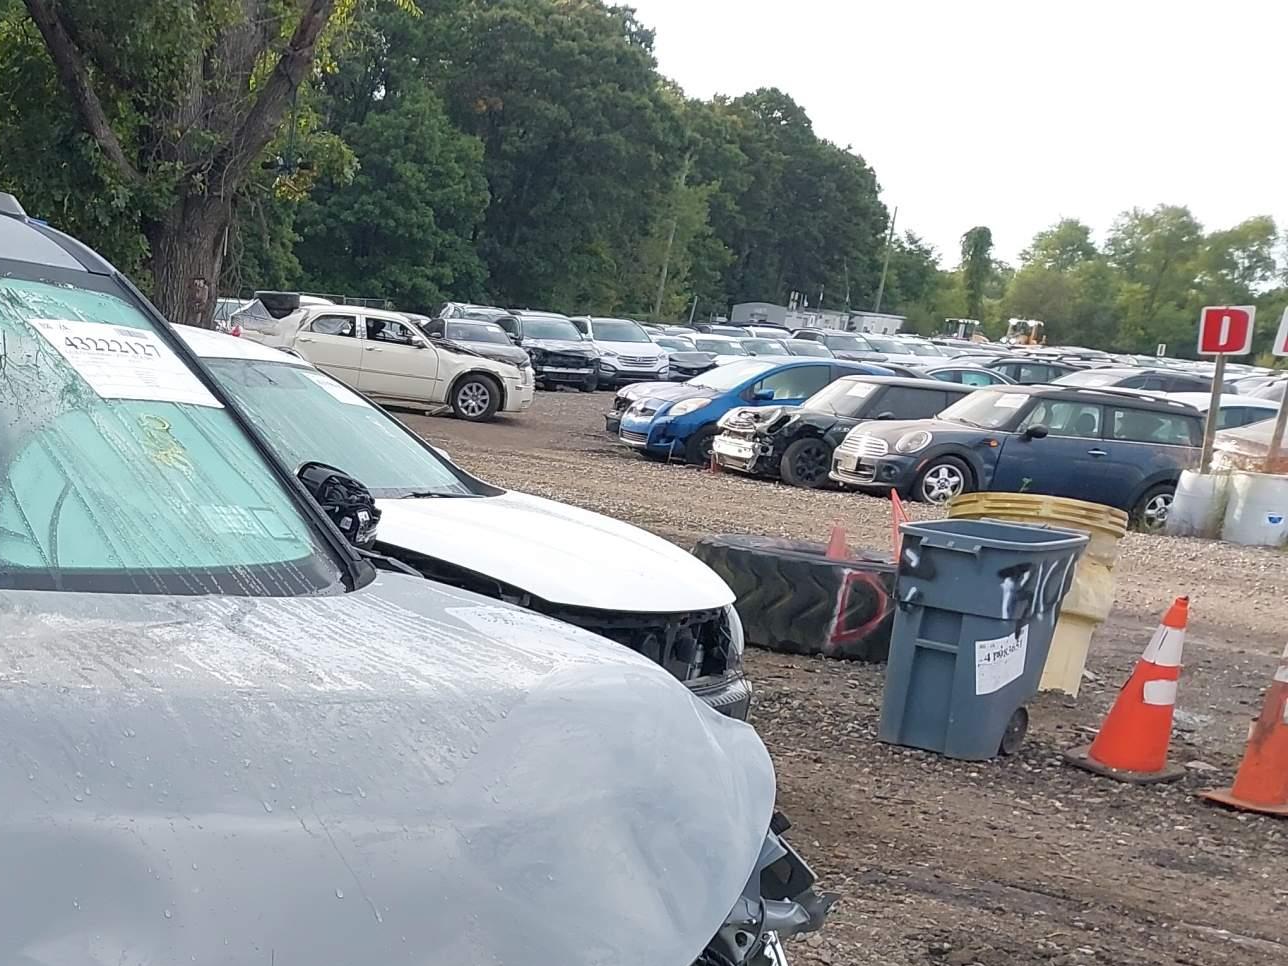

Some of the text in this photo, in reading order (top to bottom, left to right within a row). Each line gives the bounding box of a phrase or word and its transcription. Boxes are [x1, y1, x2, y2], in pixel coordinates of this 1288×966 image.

[63, 335, 162, 359] 43222127
[1201, 308, 1250, 353] D
[826, 569, 888, 645] D
